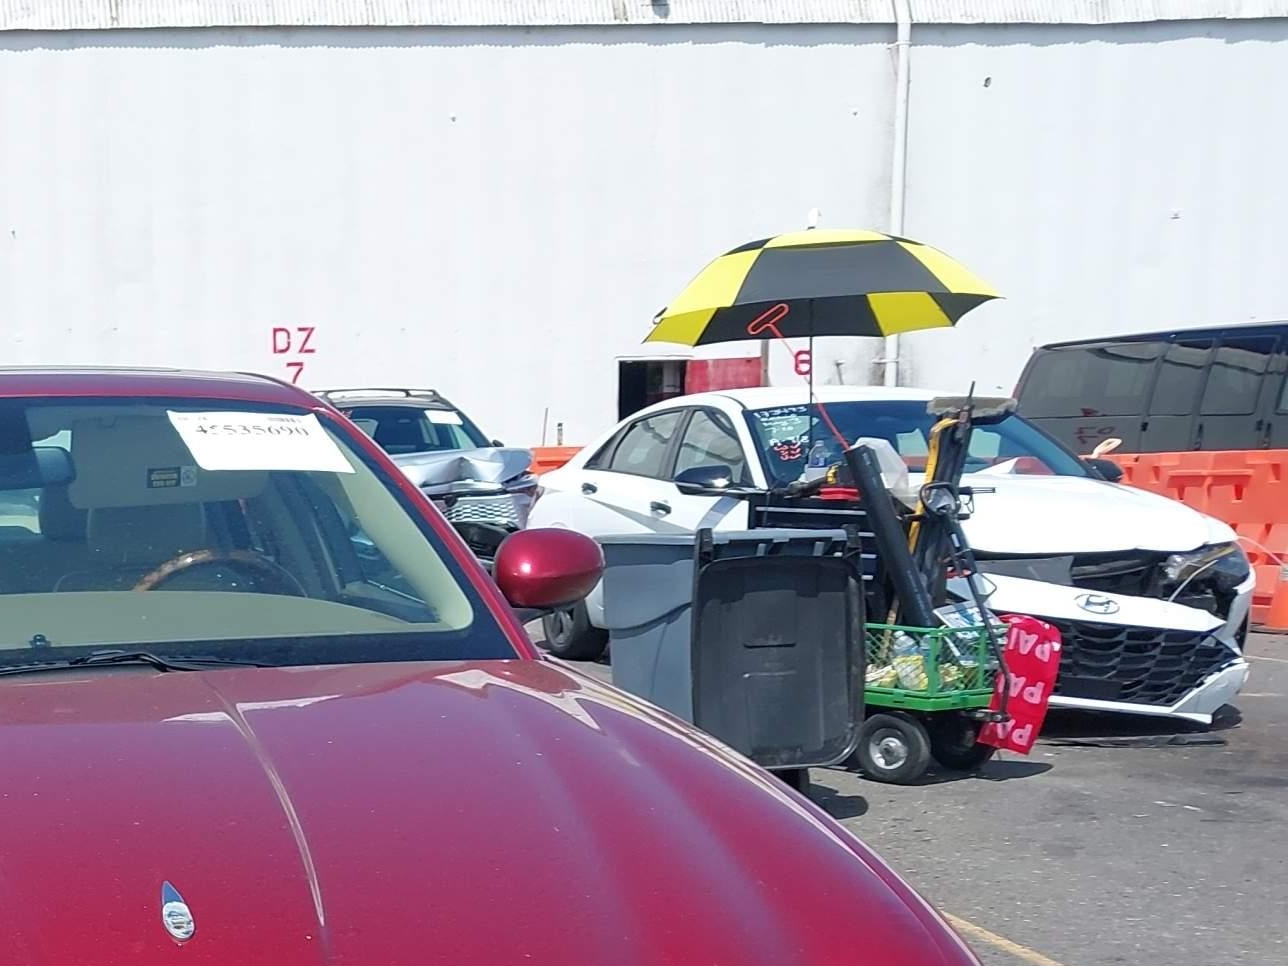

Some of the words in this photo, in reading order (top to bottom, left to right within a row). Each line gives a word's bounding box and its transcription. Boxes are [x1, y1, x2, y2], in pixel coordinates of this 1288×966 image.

[273, 327, 316, 354] DZ
[286, 362, 304, 385] 7
[794, 350, 811, 376] 6
